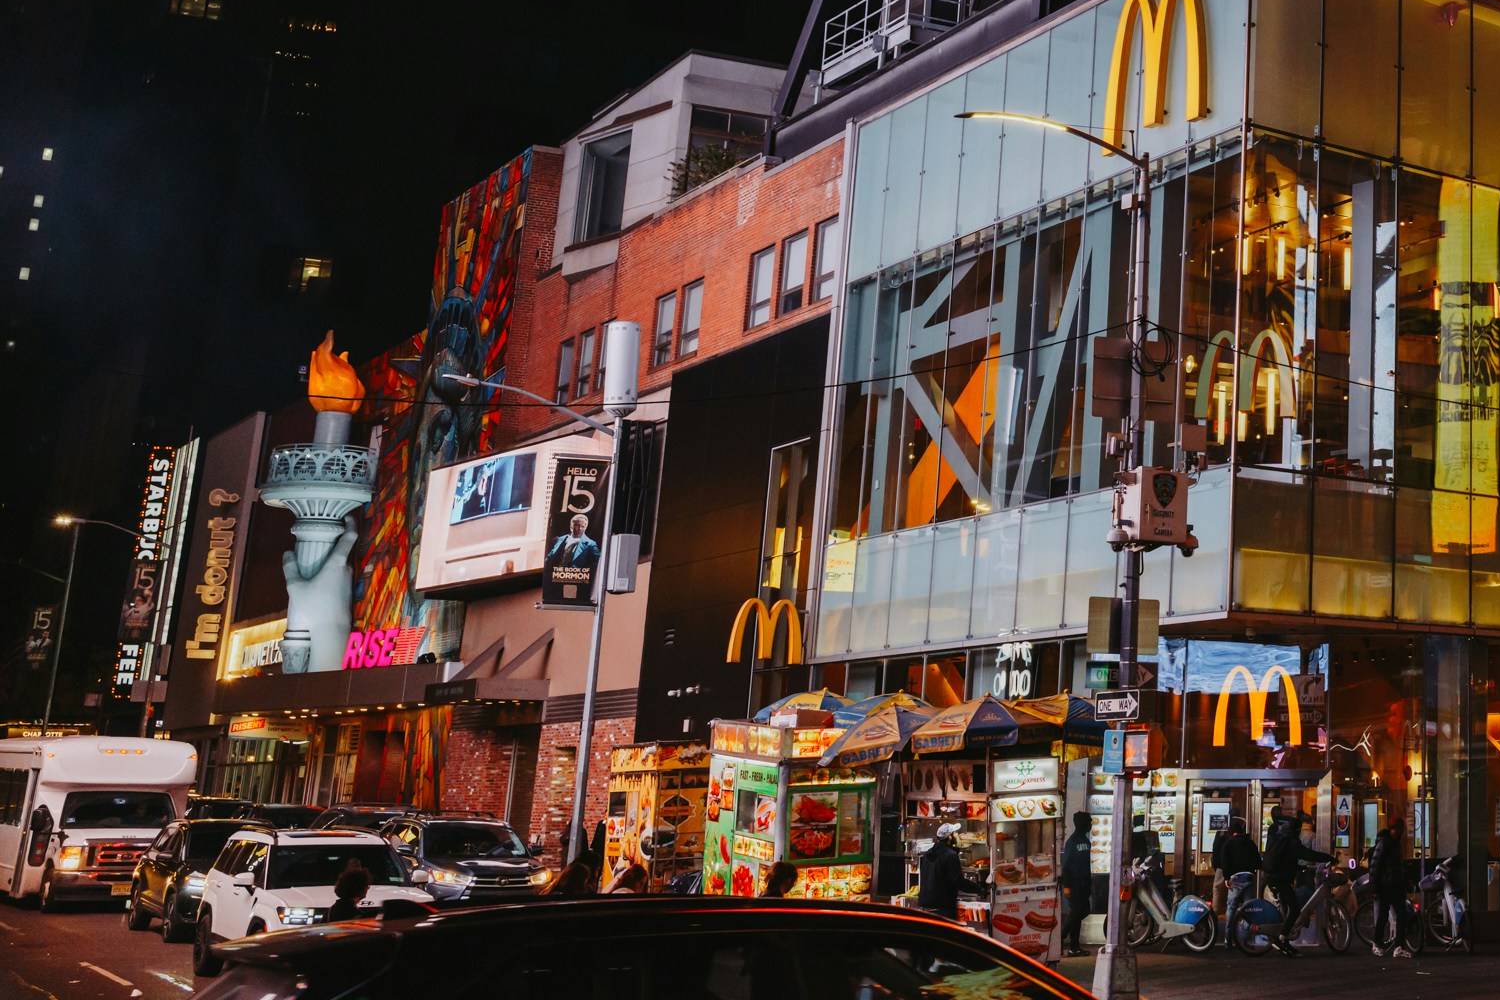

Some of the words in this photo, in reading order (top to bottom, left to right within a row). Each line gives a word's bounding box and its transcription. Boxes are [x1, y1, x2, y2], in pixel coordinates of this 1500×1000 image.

[567, 467, 598, 476] HELLO
[560, 475, 597, 514] 15
[136, 458, 170, 560] STARBUC
[195, 516, 236, 606] donut
[133, 568, 156, 589] 15
[552, 572, 590, 580] MORMON
[32, 611, 52, 630] 15
[186, 613, 222, 659] I'm
[116, 643, 139, 686] FEE
[1099, 701, 1112, 712] ONE
[1118, 699, 1133, 711] WAY
[914, 734, 962, 750] SABRETT
[1339, 798, 1349, 810] A
